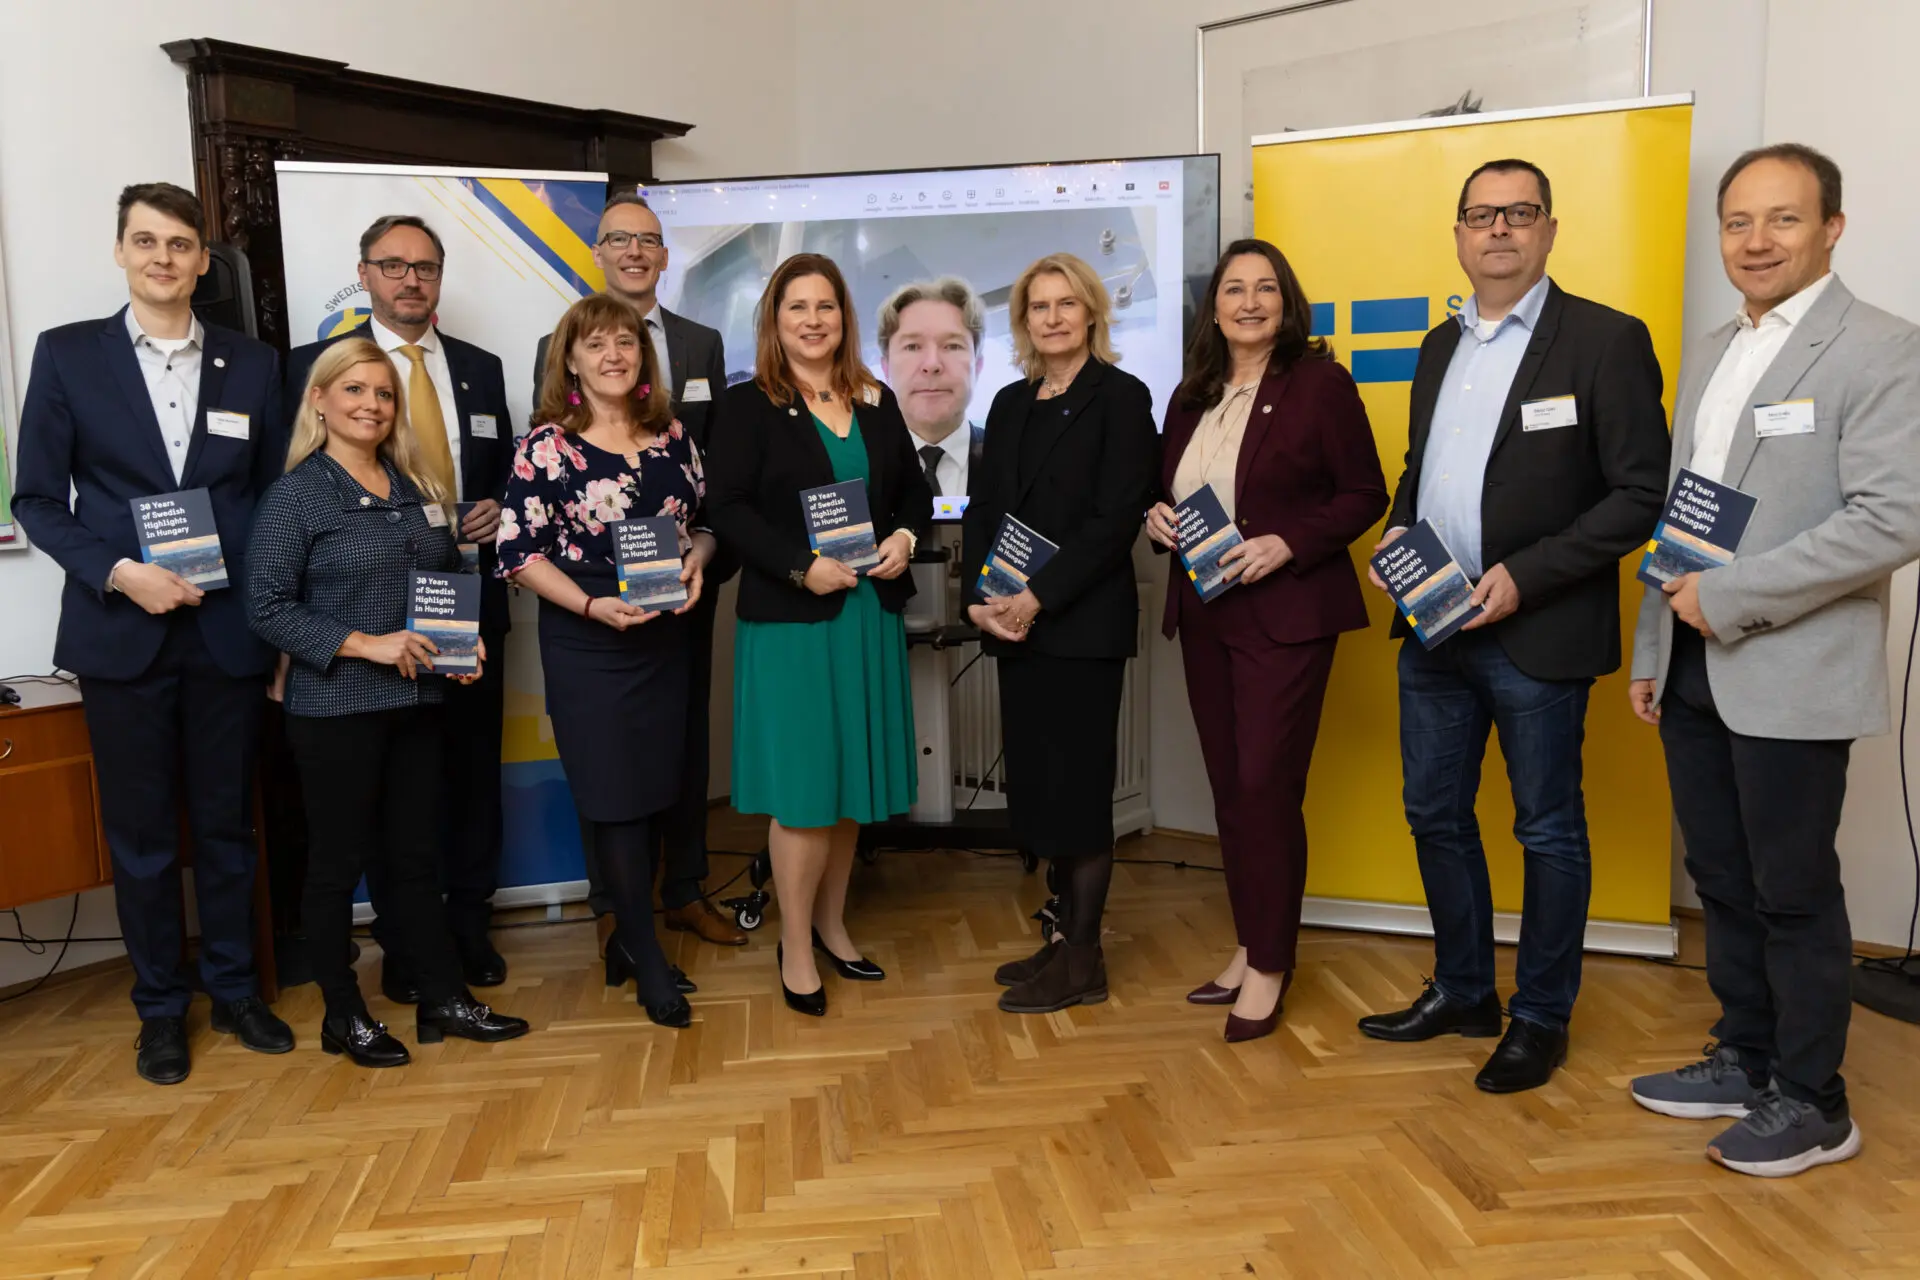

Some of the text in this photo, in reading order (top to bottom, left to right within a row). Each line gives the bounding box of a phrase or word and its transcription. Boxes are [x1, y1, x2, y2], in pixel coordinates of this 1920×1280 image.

[325, 282, 364, 312] SWEDIS
[1446, 294, 1463, 318] S
[818, 492, 836, 500] Years
[1682, 478, 1715, 498] 30 Years
[152, 500, 175, 509] Years
[818, 498, 845, 508] Swedish
[1674, 499, 1715, 523] Highlights
[1687, 492, 1719, 512] Swedish
[152, 508, 185, 518] Swedish
[811, 507, 846, 519] Highlights
[822, 516, 848, 525] Hungary
[1669, 509, 1711, 534] in Hungary
[144, 517, 187, 529] Highlights
[157, 526, 189, 536] Hungary
[1178, 518, 1204, 539] ighlights
[628, 532, 655, 540] Swedish
[1007, 523, 1029, 542] 30 Years
[1186, 525, 1209, 543] Hungary
[621, 541, 656, 550] Highlights
[1000, 538, 1029, 560] Highlights
[1010, 535, 1032, 553] Swedish
[1004, 550, 1027, 568] Hungary
[1378, 546, 1405, 567] 30 Years
[1385, 549, 1416, 575] of Swedish
[1389, 557, 1422, 583] Highlights
[1394, 565, 1427, 592] in Hungary
[425, 587, 455, 595] Swedish
[416, 596, 455, 605] Highlights
[425, 606, 455, 615] Hungary
